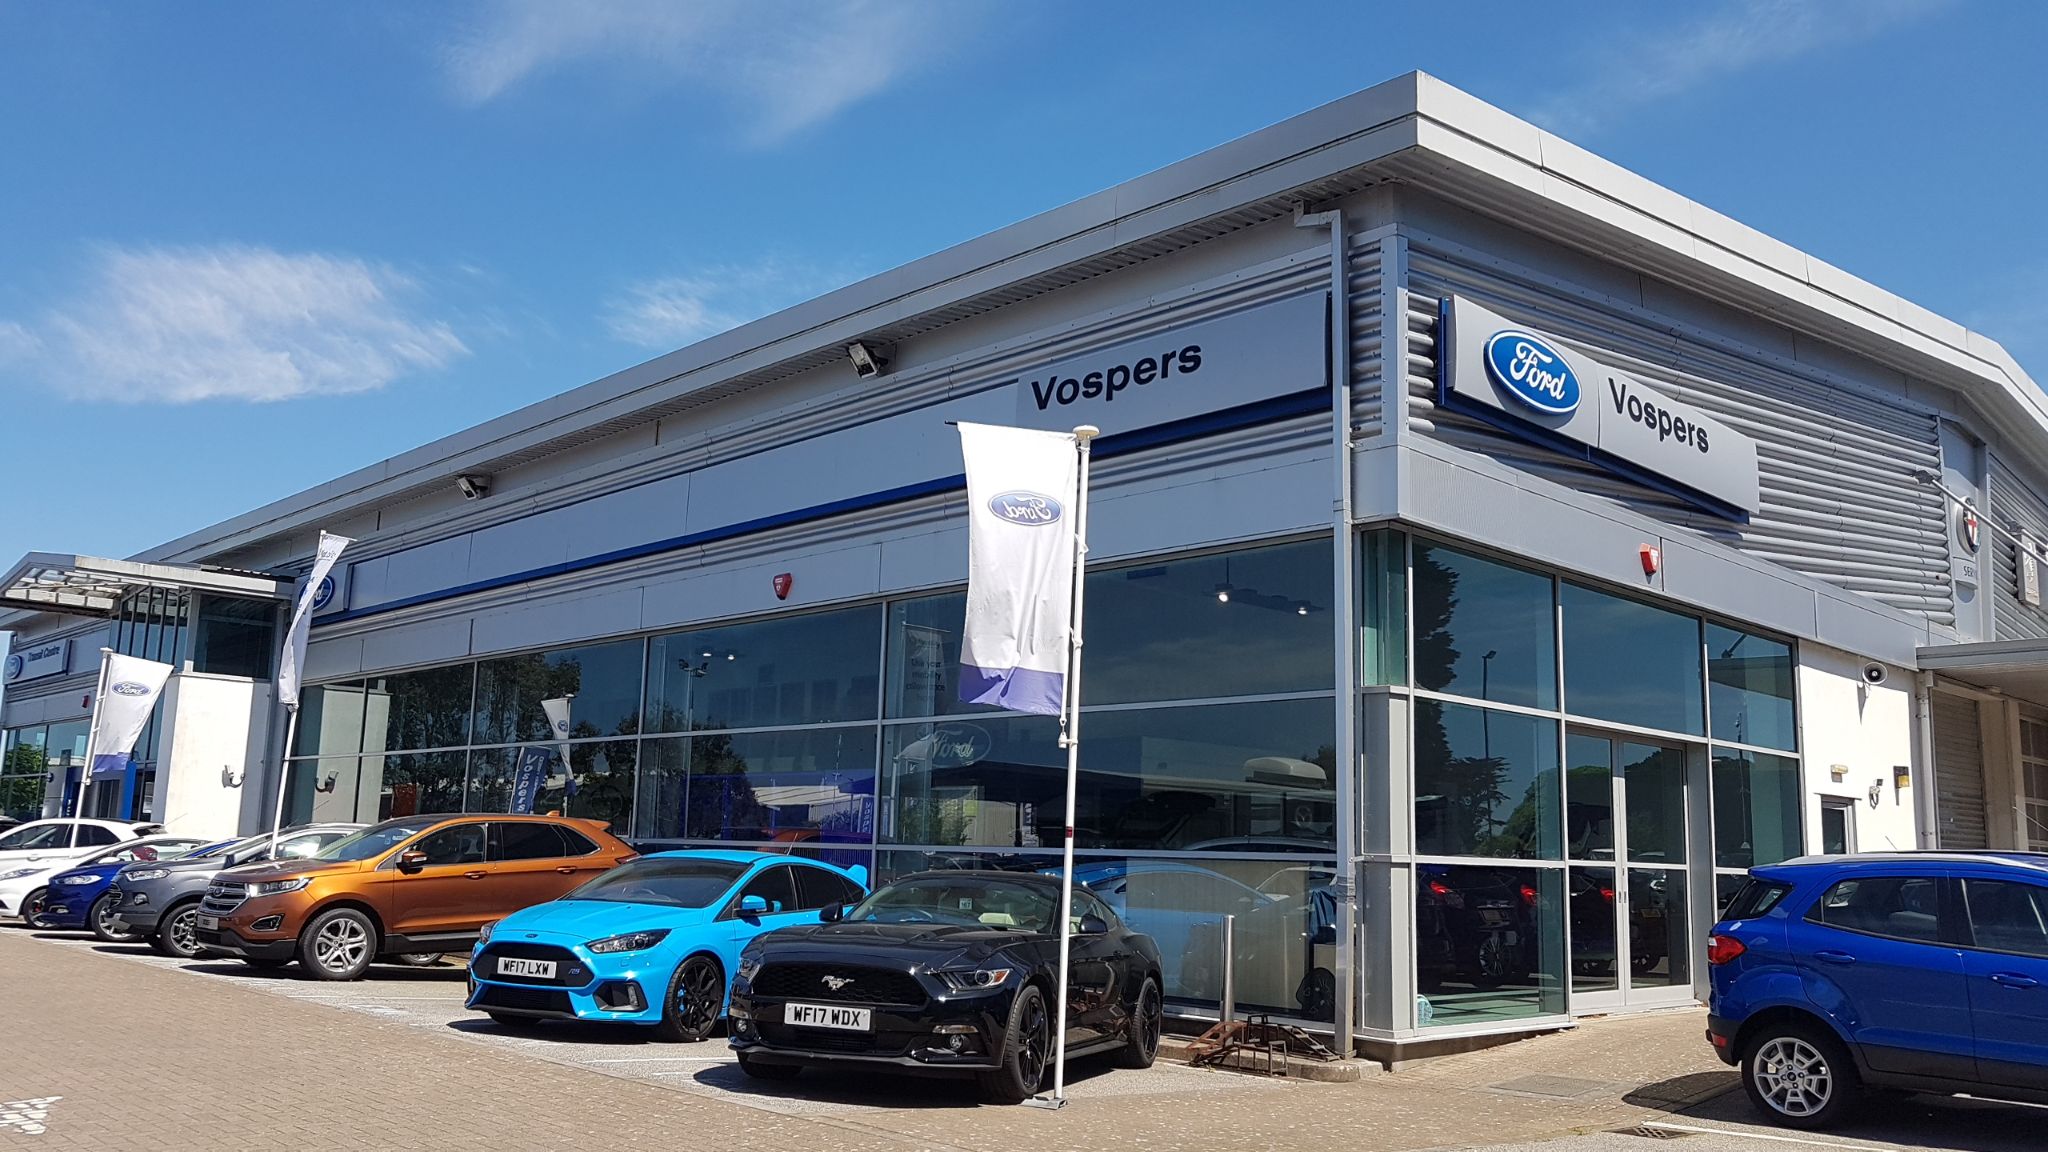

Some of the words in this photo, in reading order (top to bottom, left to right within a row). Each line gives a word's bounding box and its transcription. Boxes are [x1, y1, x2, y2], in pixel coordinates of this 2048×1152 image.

[1031, 344, 1202, 411] Vospers
[1510, 341, 1566, 401] Ford
[1608, 377, 1709, 454] Vospers
[117, 683, 146, 695] Ford
[517, 754, 539, 812] Vospers
[503, 959, 526, 974] WF17
[527, 961, 550, 976] LXW
[793, 1005, 827, 1024] WF17
[831, 1009, 861, 1027] WDX
